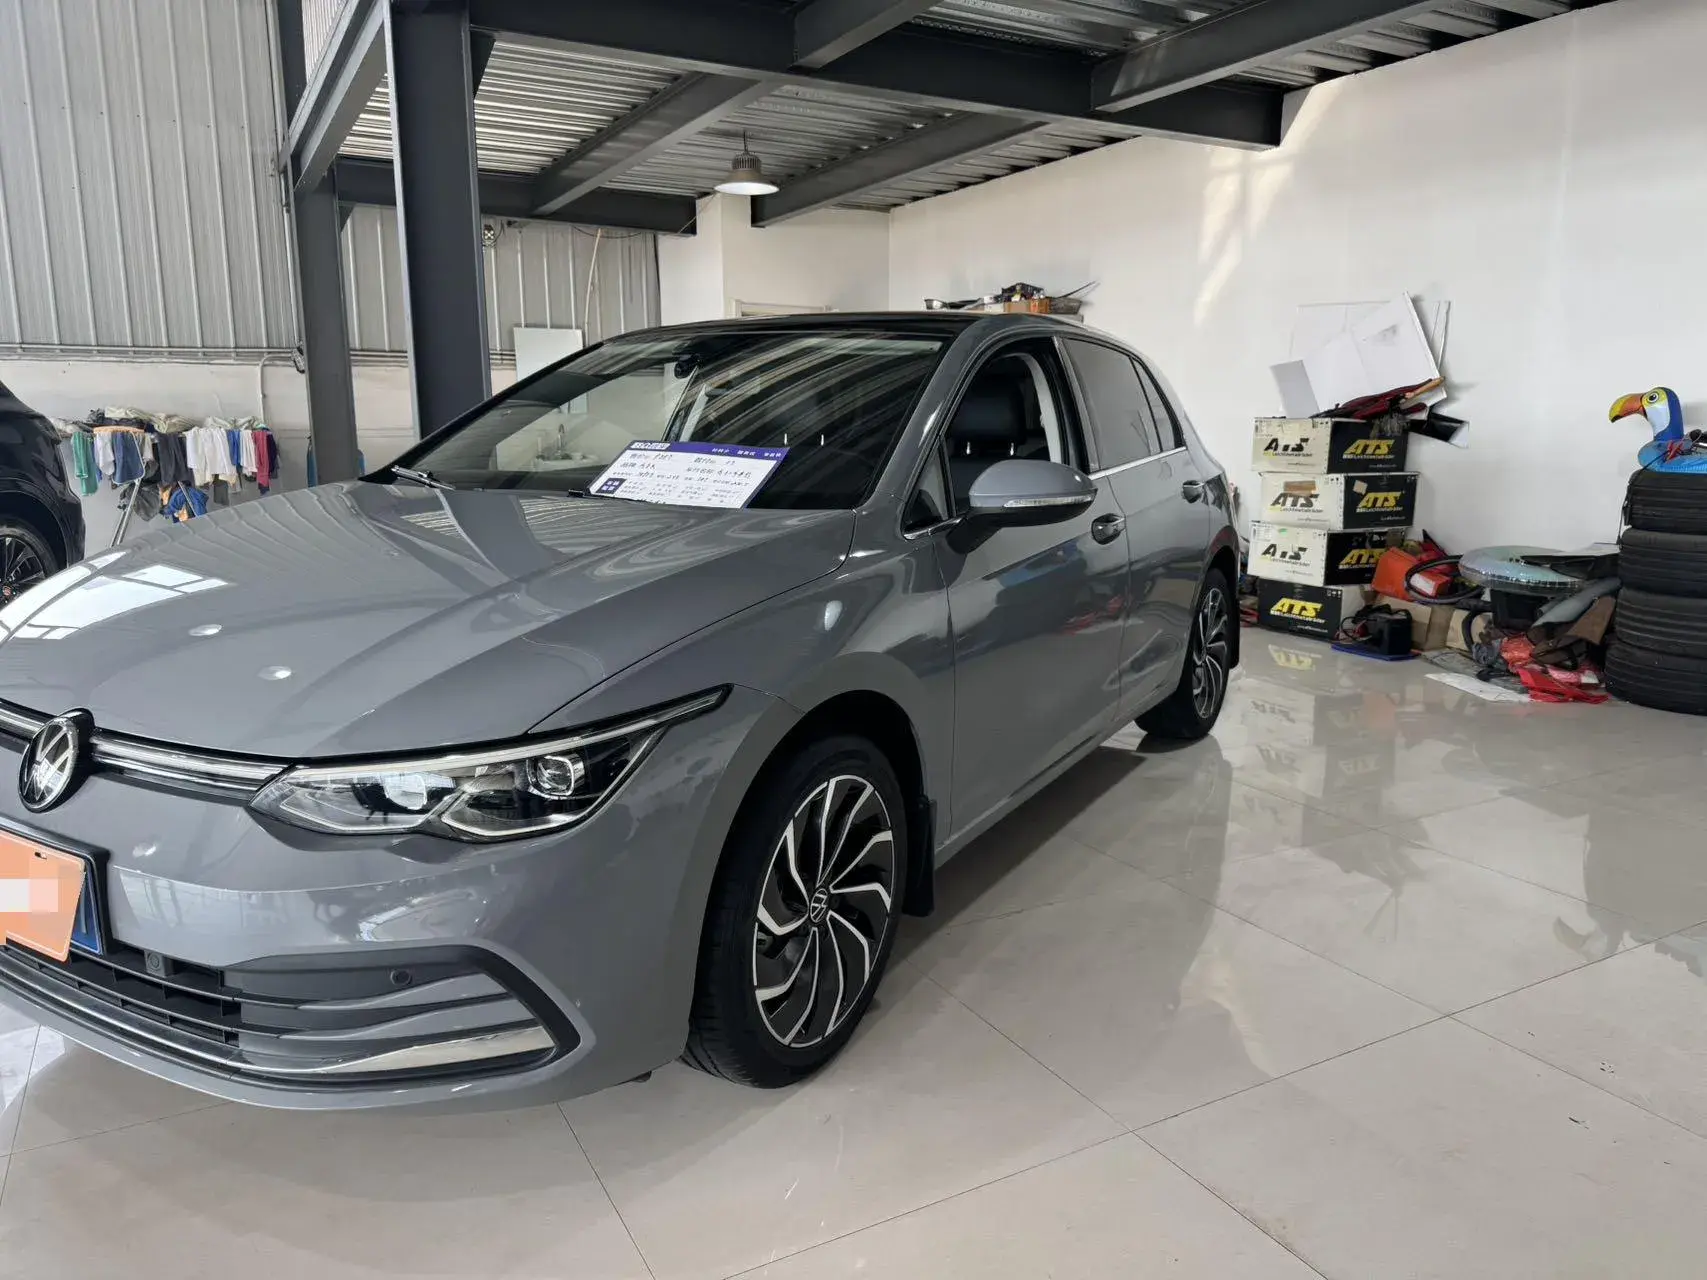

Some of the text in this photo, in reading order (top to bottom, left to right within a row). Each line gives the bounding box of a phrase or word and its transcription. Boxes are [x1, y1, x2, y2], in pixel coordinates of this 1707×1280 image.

[1344, 440, 1395, 455] ATS
[1270, 493, 1319, 508] ATS
[1357, 492, 1402, 508] ATS
[1270, 598, 1322, 618] ATS
